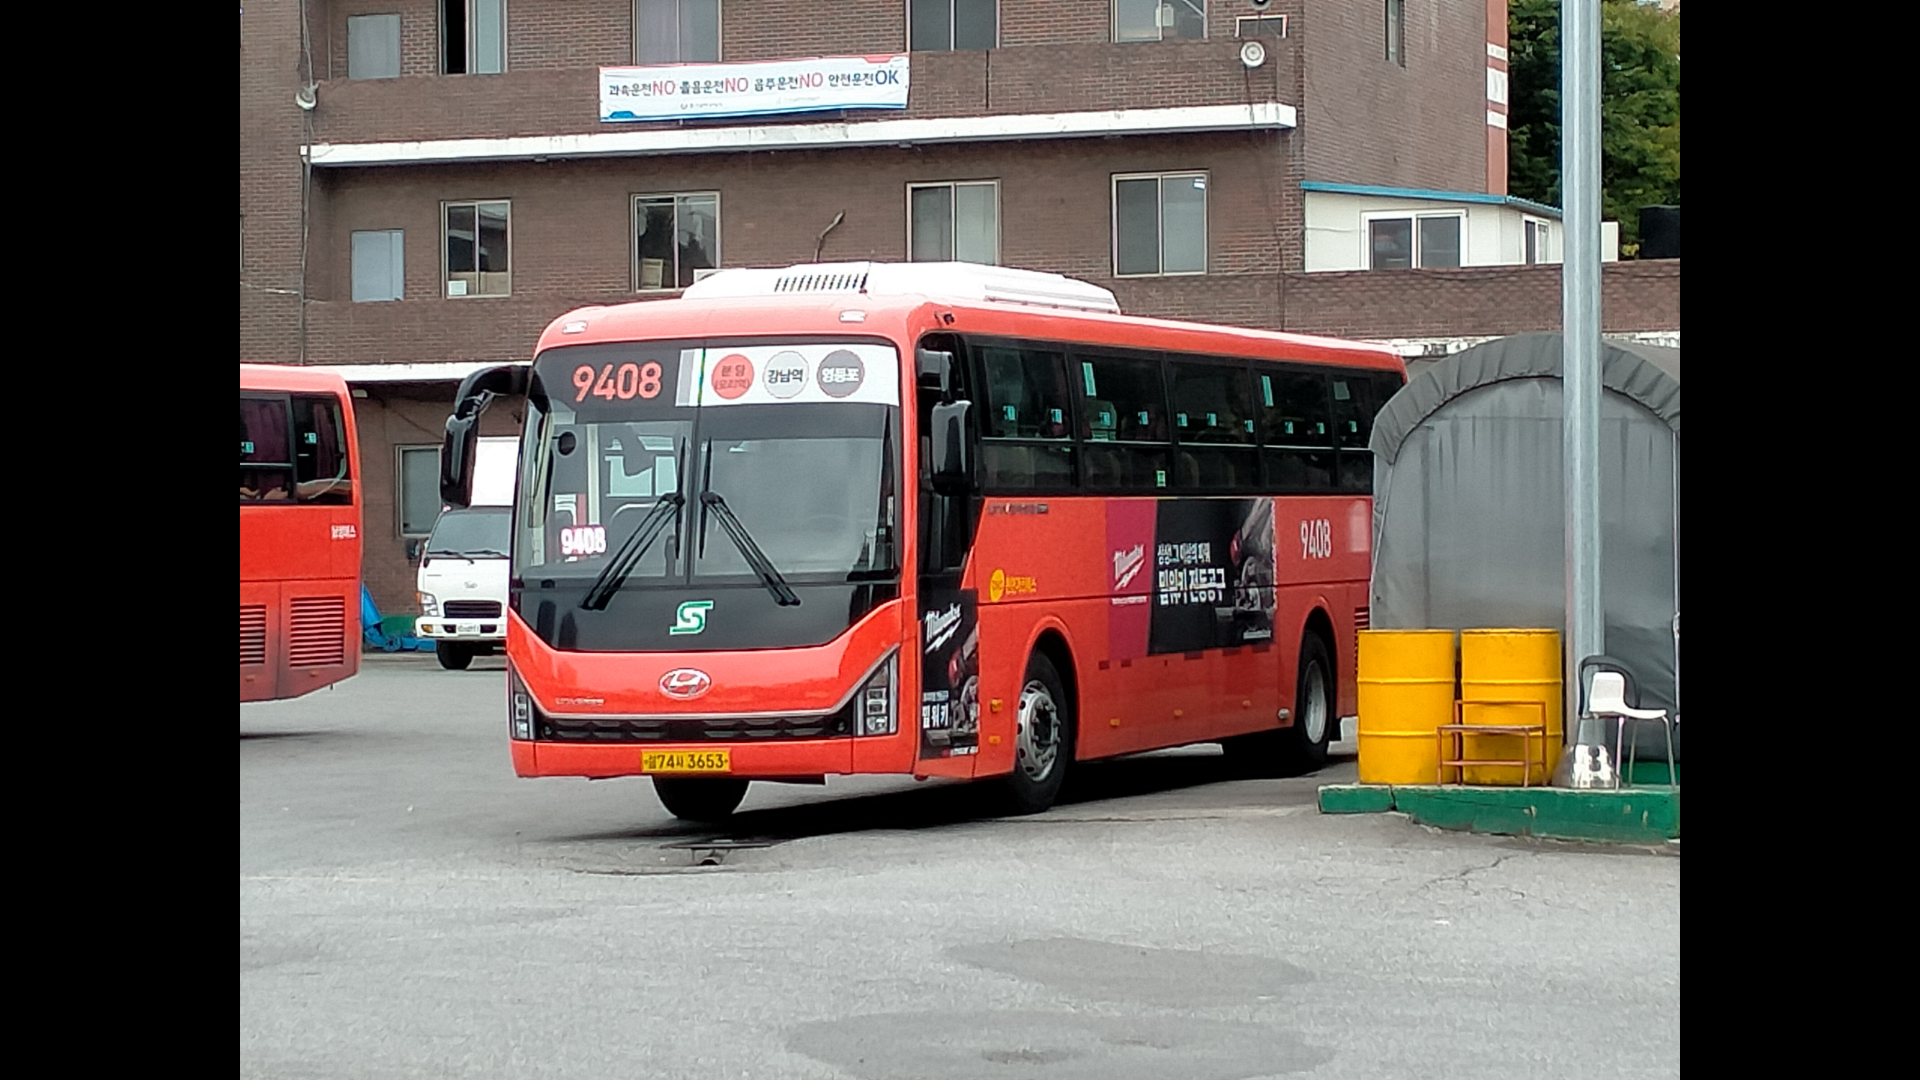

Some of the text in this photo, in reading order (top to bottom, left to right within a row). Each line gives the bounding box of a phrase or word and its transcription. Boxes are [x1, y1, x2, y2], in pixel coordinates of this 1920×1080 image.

[572, 361, 663, 402] 9408
[767, 368, 804, 384] 강남역
[822, 366, 860, 383] 영등포
[561, 526, 607, 555] 9408
[1300, 518, 1332, 560] 9408
[687, 753, 725, 769] 3653
